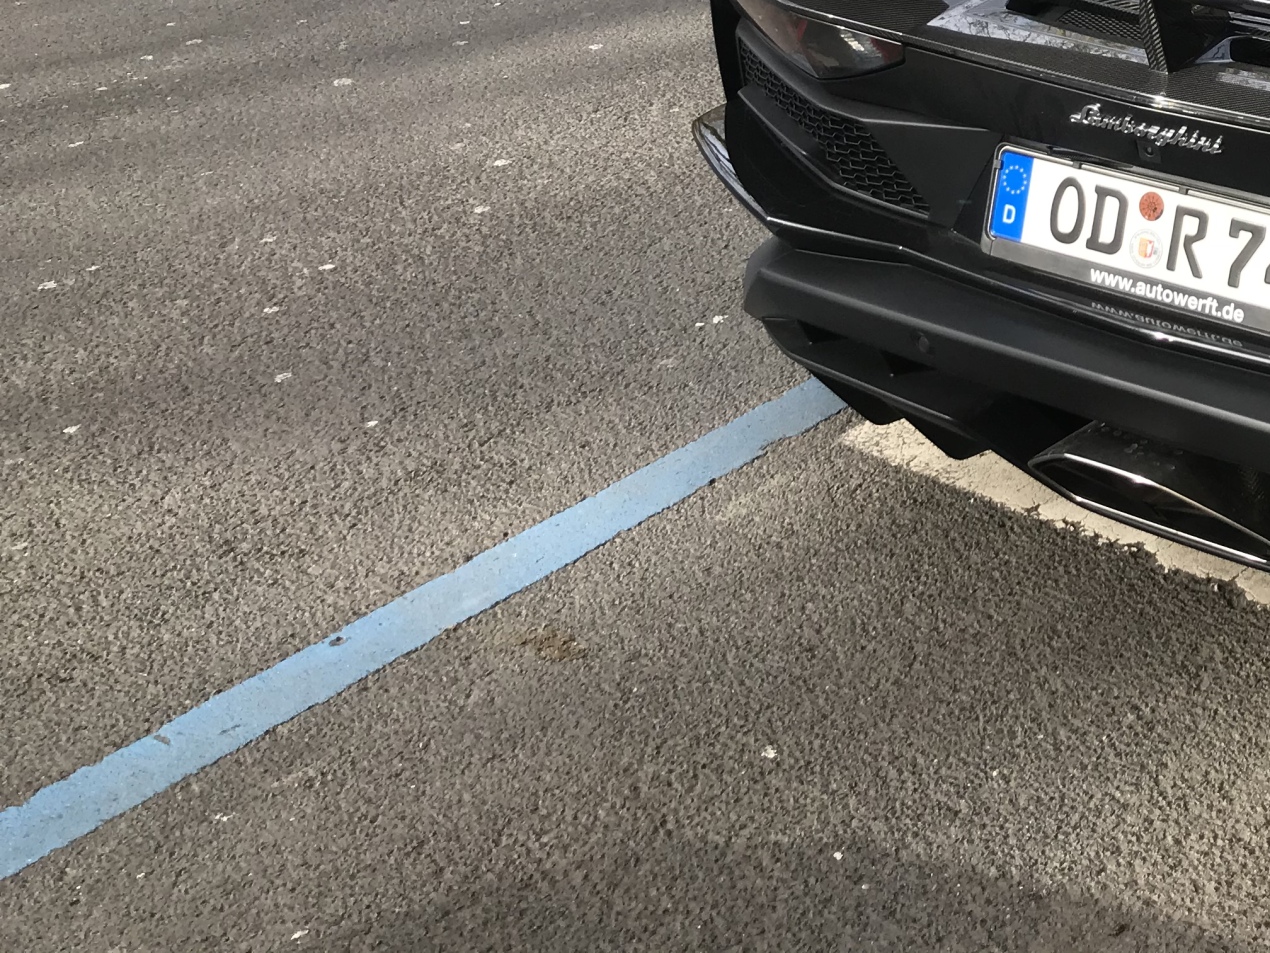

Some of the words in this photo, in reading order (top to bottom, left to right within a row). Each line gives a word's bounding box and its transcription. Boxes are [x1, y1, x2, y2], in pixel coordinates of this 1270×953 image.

[1069, 103, 1227, 157] Lamborghini
[1002, 203, 1016, 225] D
[1049, 176, 1129, 255] OD
[1165, 204, 1210, 279] R
[1090, 267, 1245, 324] www.autowerft.de
